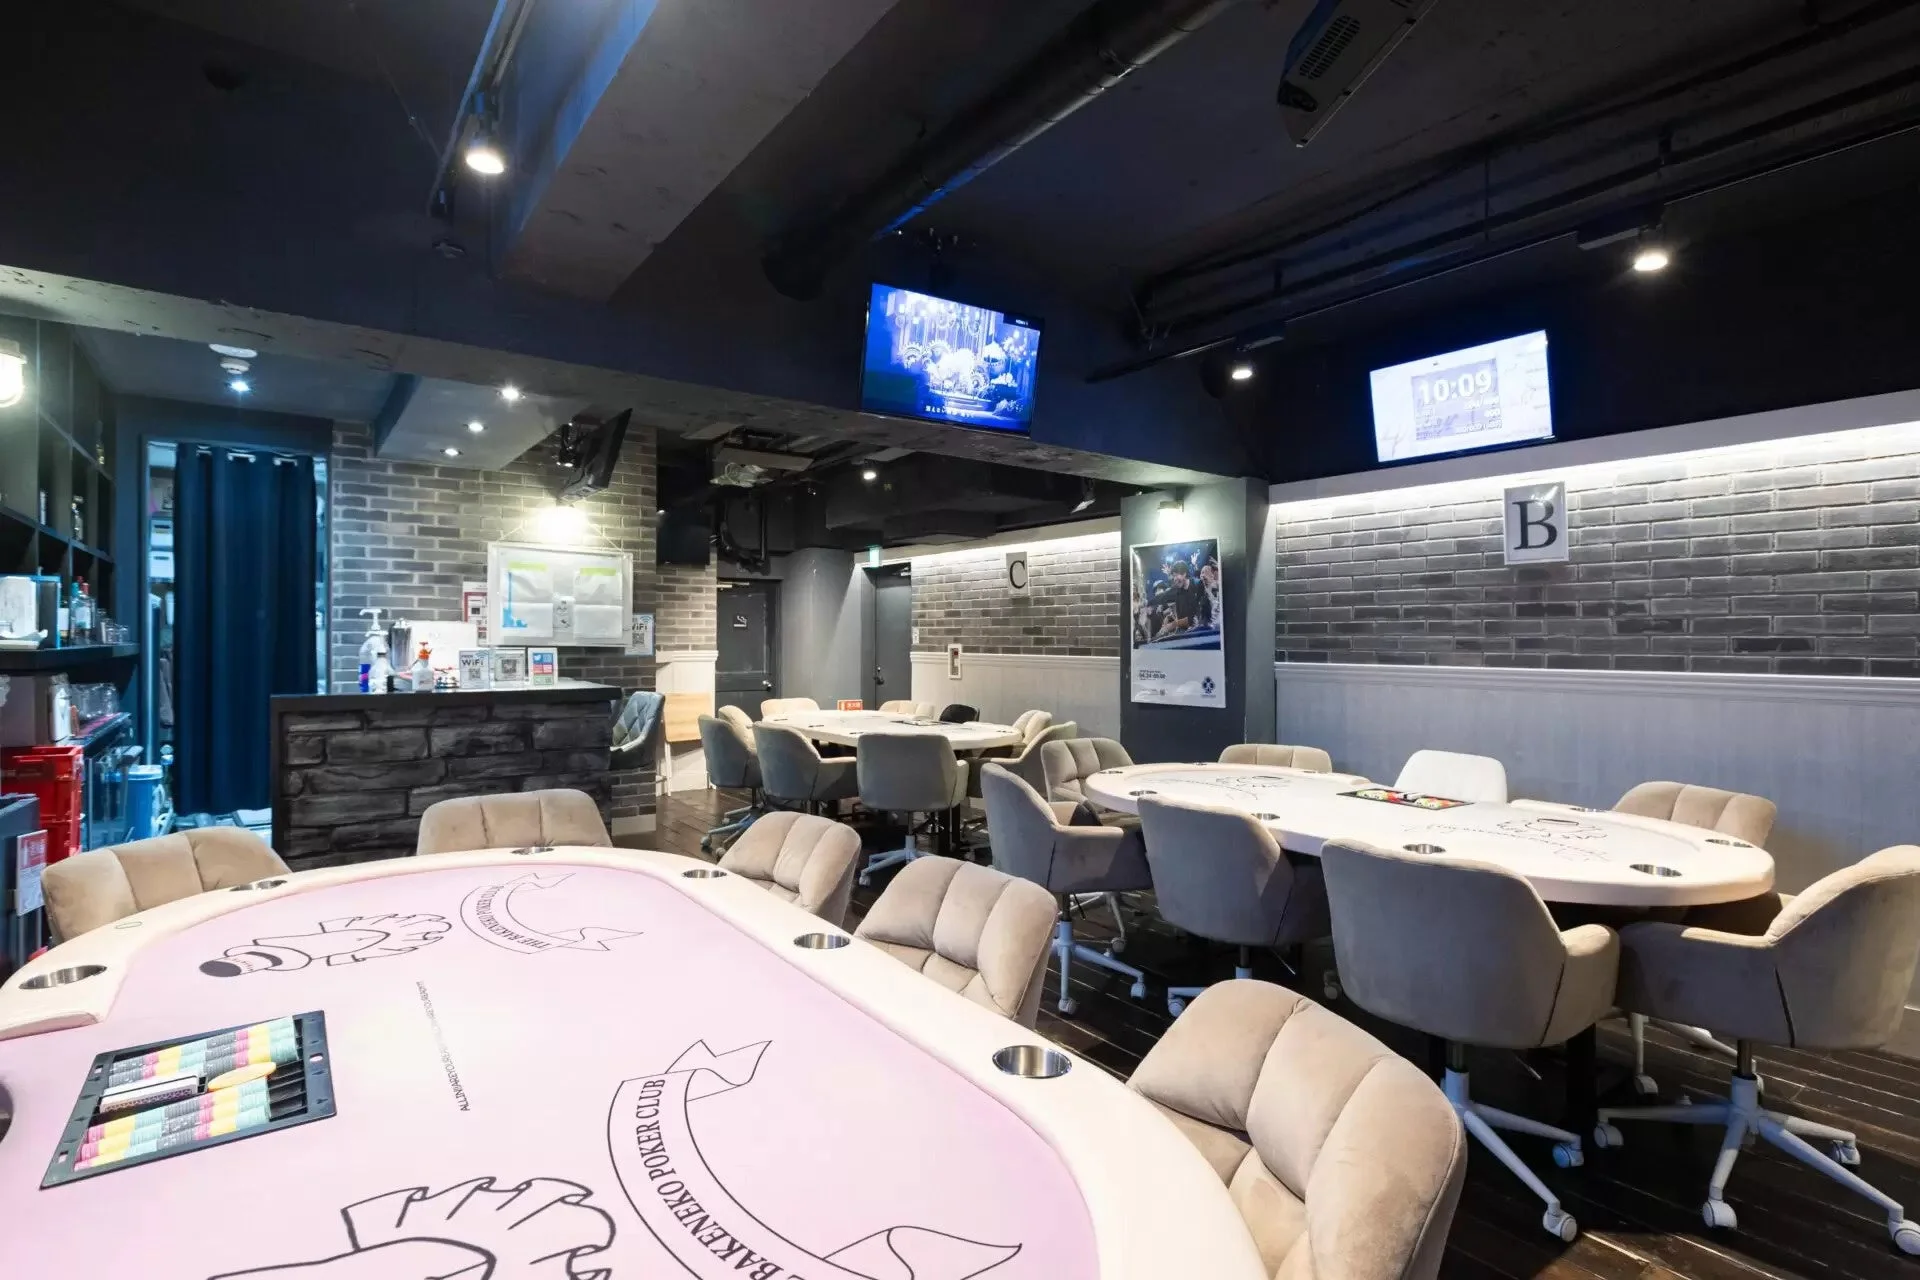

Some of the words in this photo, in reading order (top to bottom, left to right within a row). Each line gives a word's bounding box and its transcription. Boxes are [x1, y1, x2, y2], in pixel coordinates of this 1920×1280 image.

[1419, 369, 1492, 404] 10:09
[1512, 500, 1558, 550] B
[1009, 560, 1027, 589] C
[636, 1079, 666, 1119] CLUB
[635, 1120, 677, 1181] POKER
[657, 1180, 784, 1280] BAKENEKO
